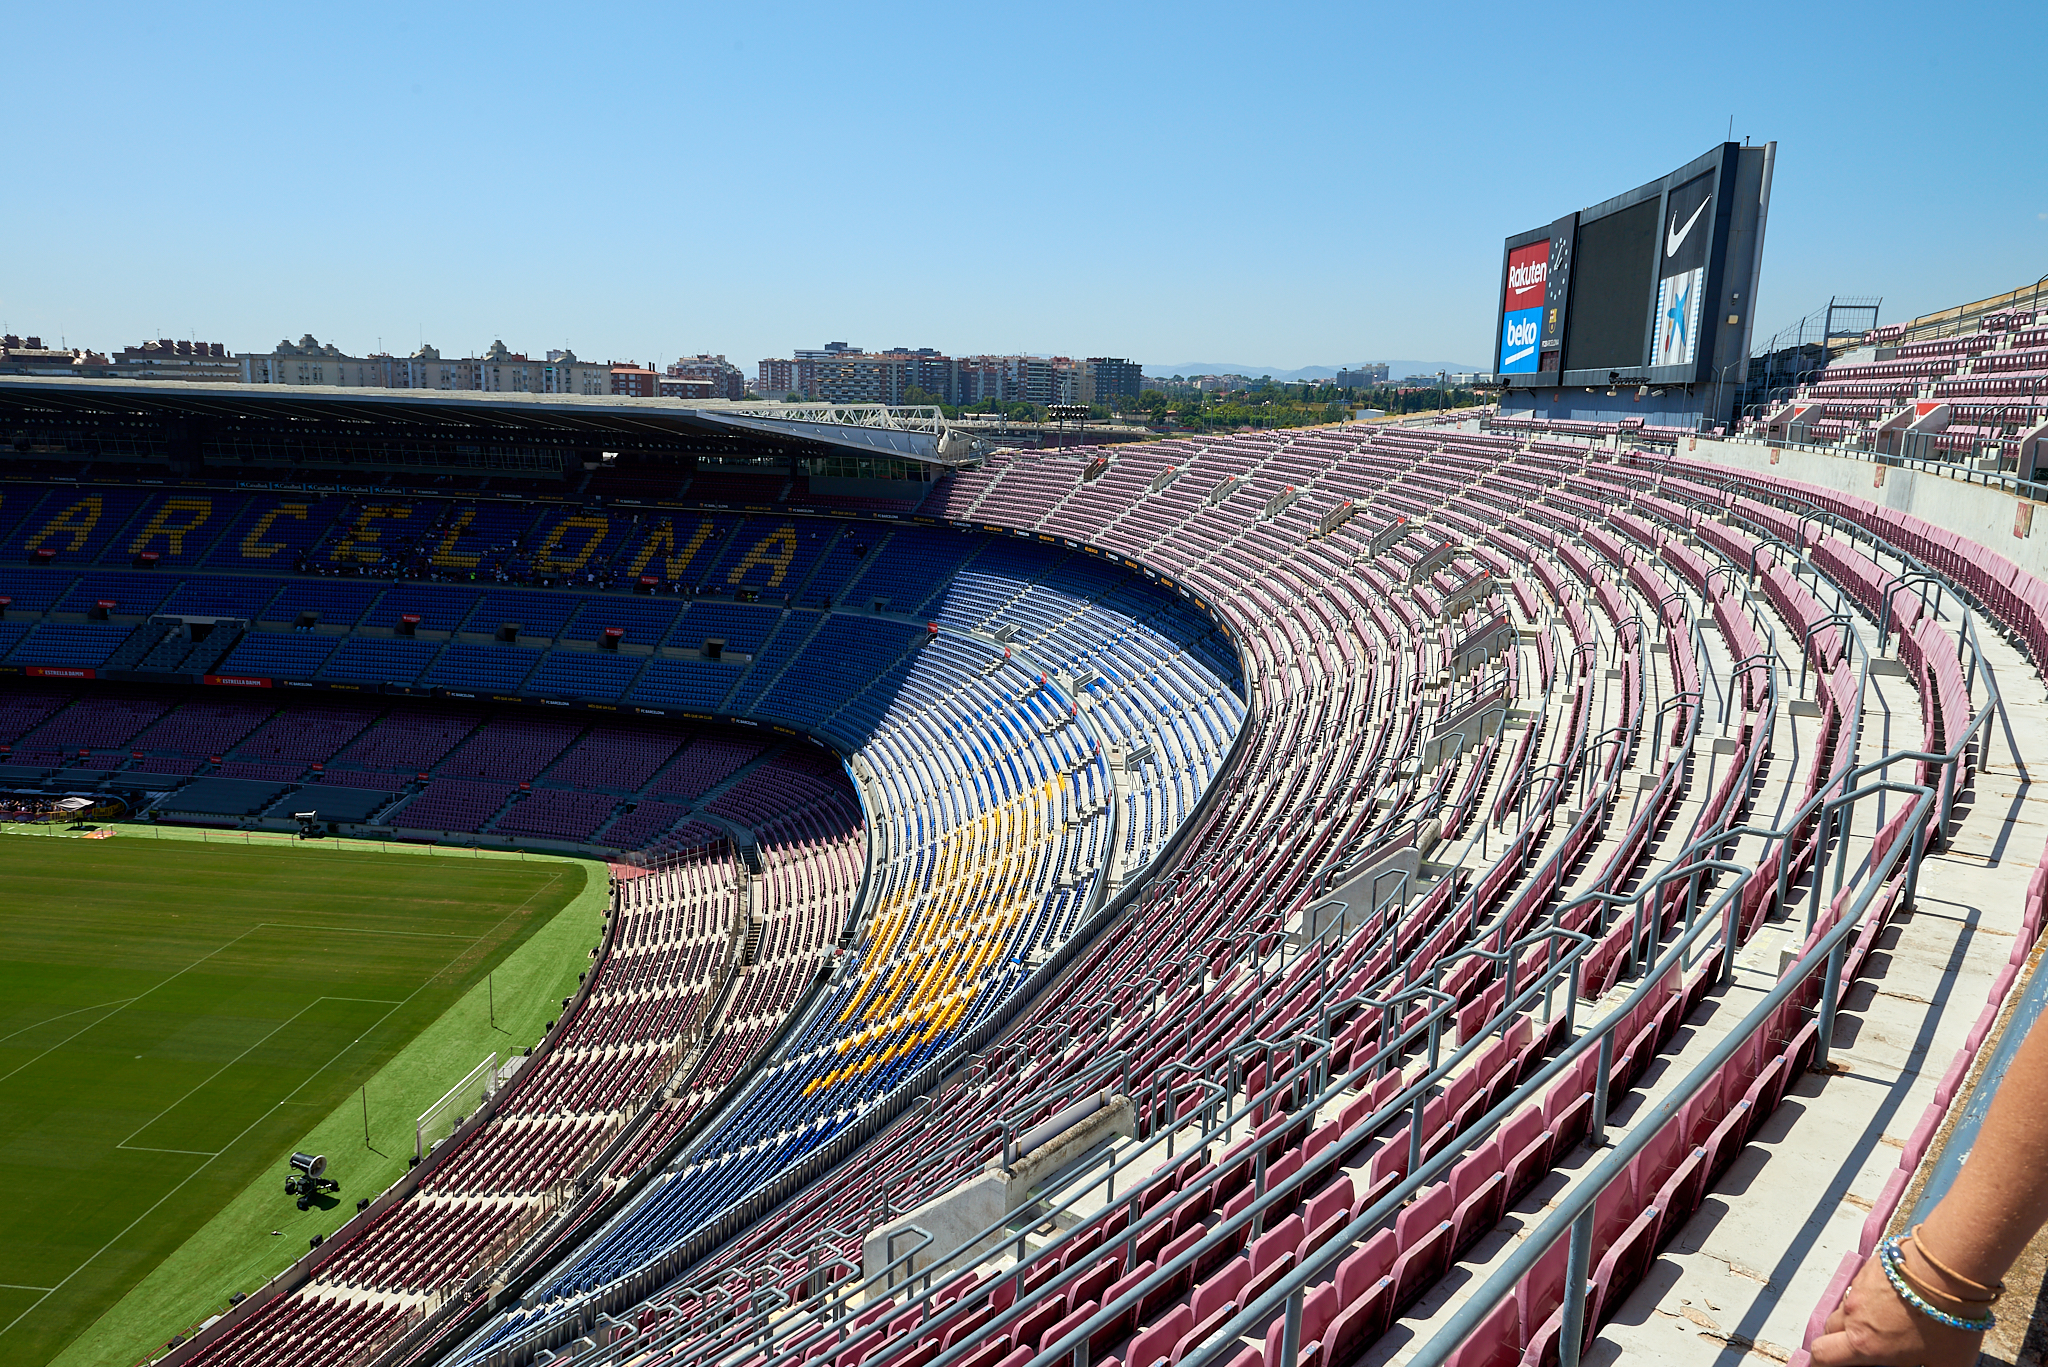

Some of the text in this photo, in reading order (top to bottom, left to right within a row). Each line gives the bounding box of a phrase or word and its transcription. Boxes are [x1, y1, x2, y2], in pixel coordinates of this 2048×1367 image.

[1508, 261, 1547, 288] Rakuten
[1507, 318, 1537, 347] beko
[0, 491, 798, 588] ARCELONA
